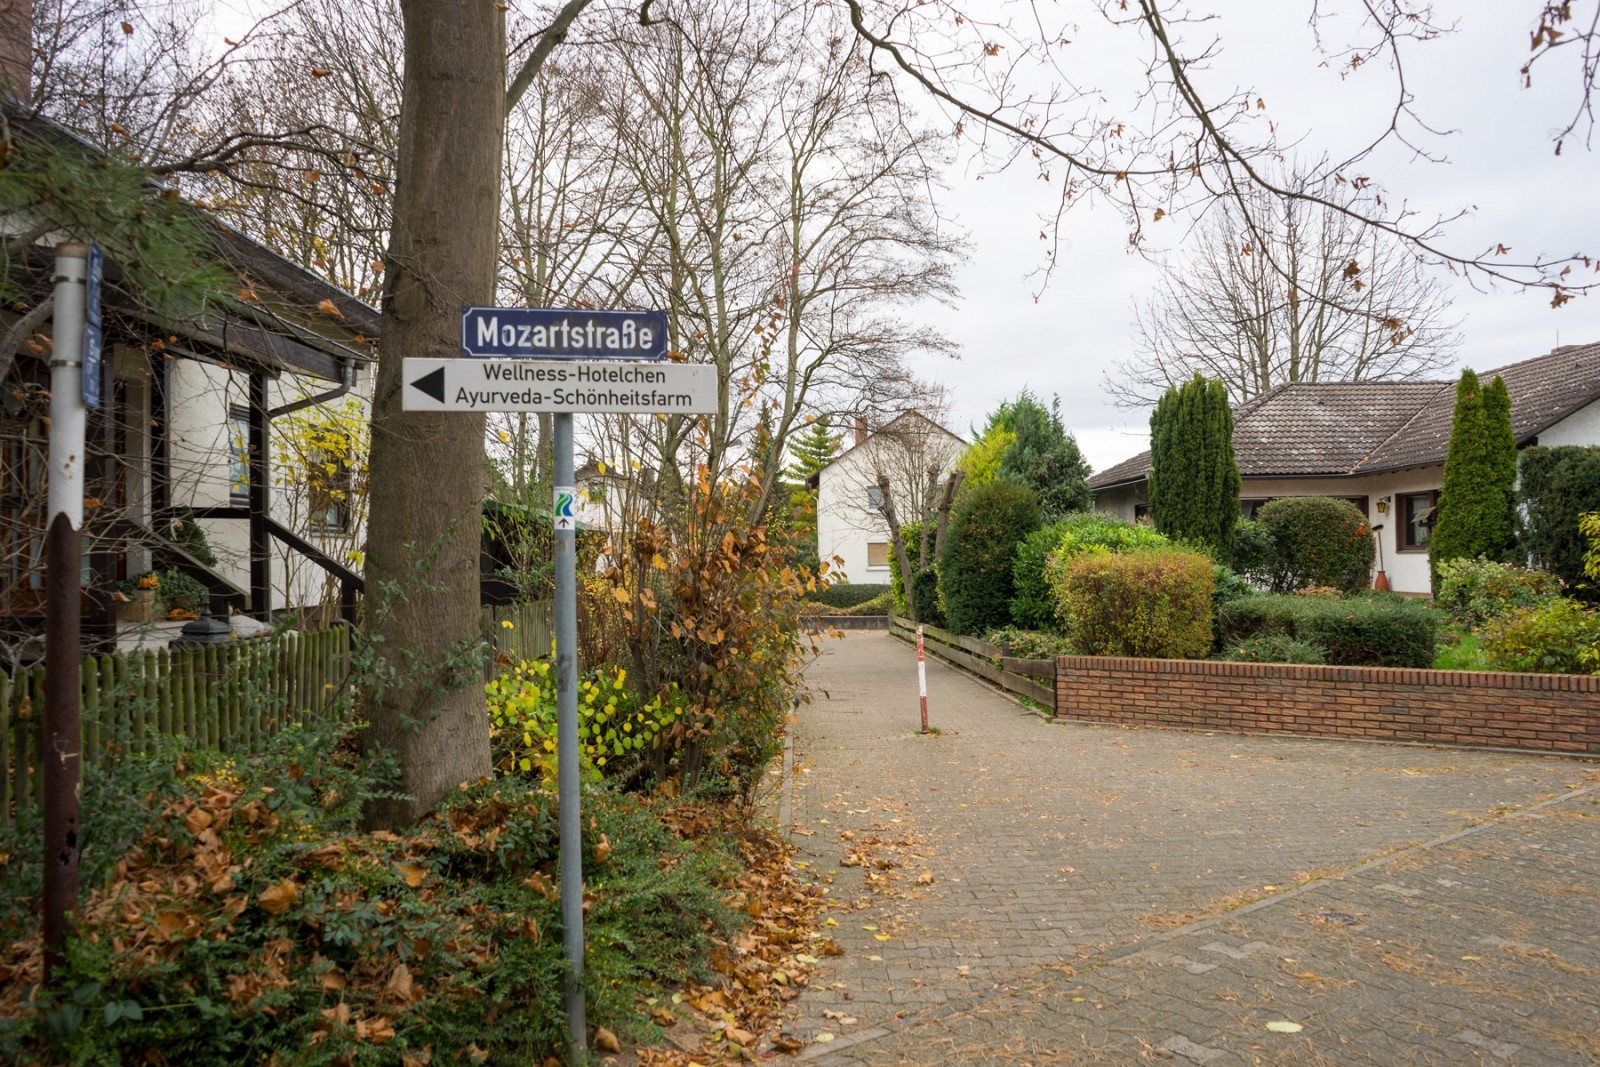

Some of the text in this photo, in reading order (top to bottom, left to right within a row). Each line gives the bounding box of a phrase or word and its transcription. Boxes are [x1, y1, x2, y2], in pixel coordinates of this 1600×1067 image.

[477, 316, 653, 349] Mozartstraße
[483, 363, 666, 384] Wellness-Hotelchen
[456, 387, 692, 408] Ayurveda-Schönheitsfarm
